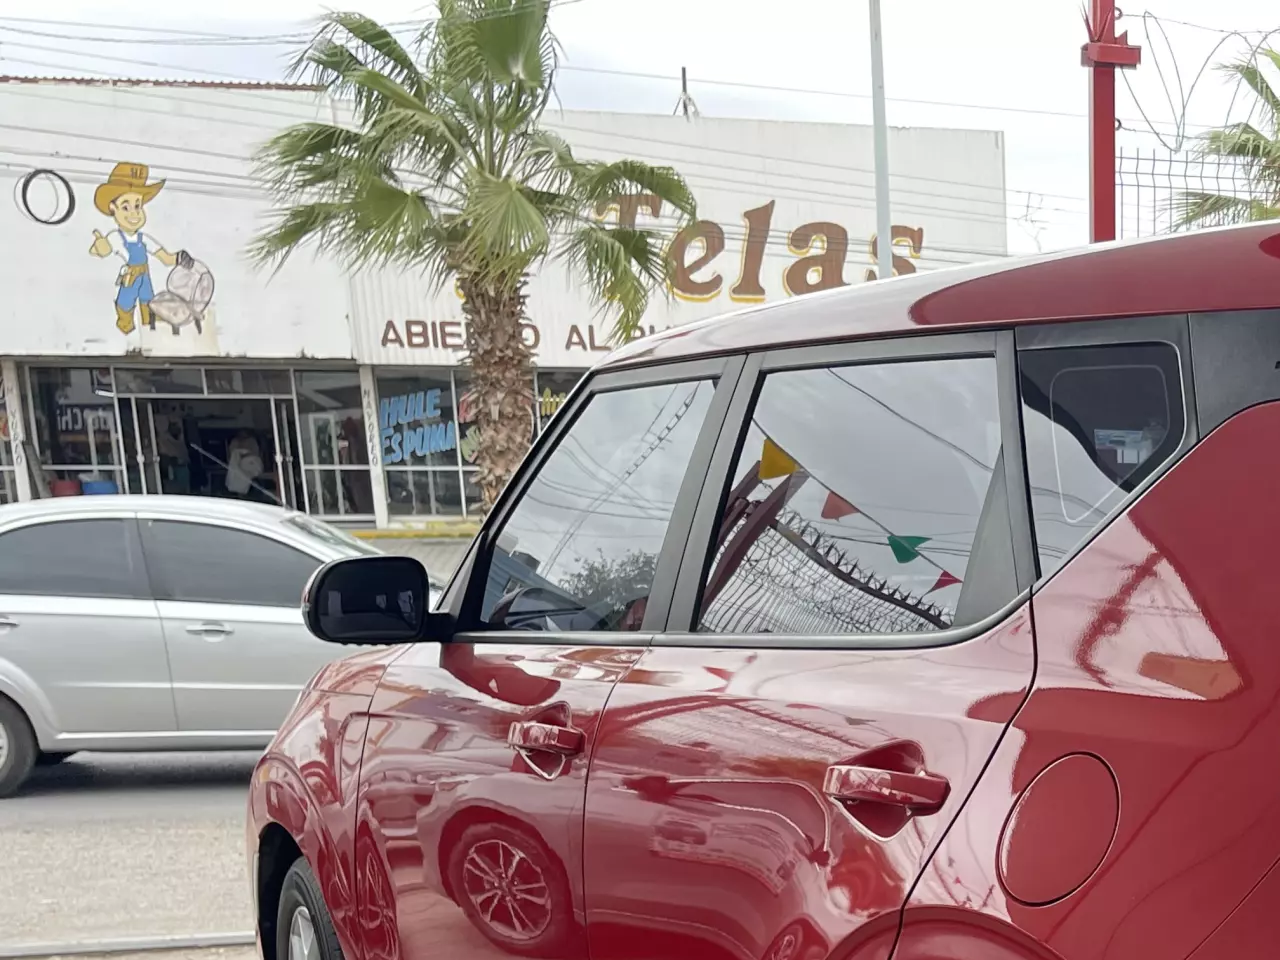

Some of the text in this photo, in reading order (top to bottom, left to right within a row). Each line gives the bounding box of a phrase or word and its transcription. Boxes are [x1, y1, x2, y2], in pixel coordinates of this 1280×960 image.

[592, 192, 925, 303] Telas
[381, 319, 540, 351] ABIEO
[565, 324, 611, 351] AL
[380, 387, 441, 428] HULE
[380, 420, 456, 464] ESPUMA
